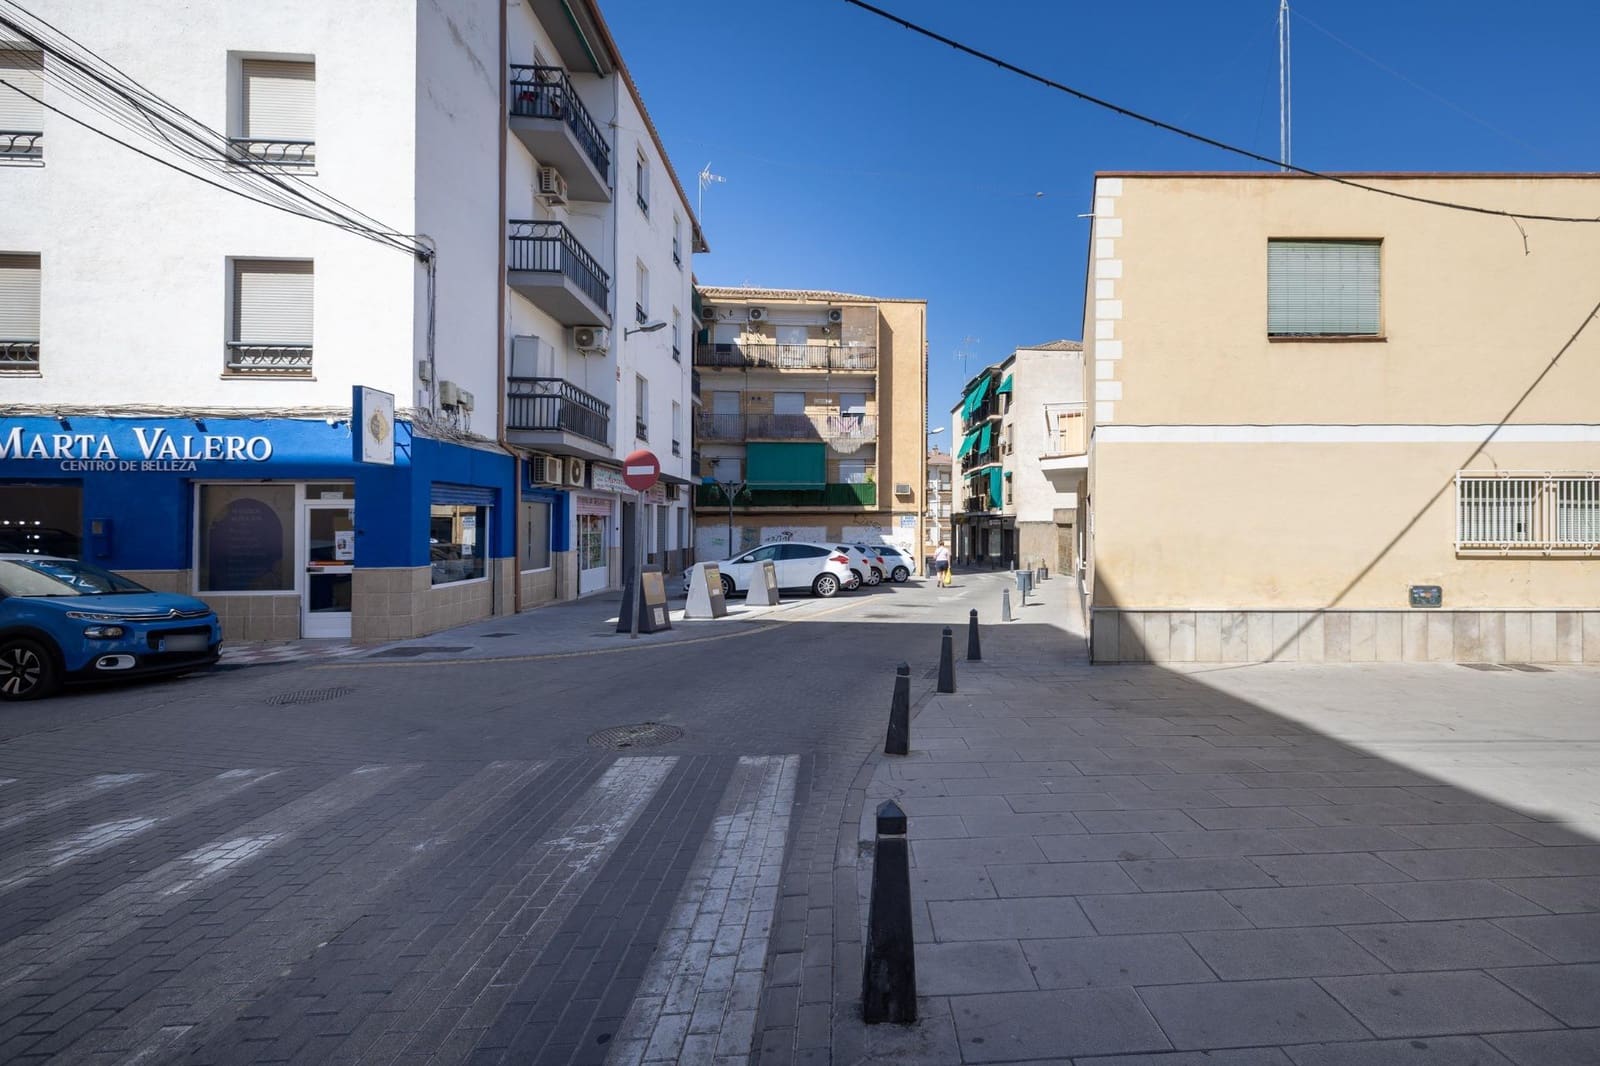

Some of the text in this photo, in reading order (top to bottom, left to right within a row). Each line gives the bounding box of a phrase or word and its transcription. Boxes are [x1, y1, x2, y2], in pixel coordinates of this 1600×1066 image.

[132, 427, 272, 460] VALERO
[60, 460, 197, 471] CENTRO DE BELLEZA
